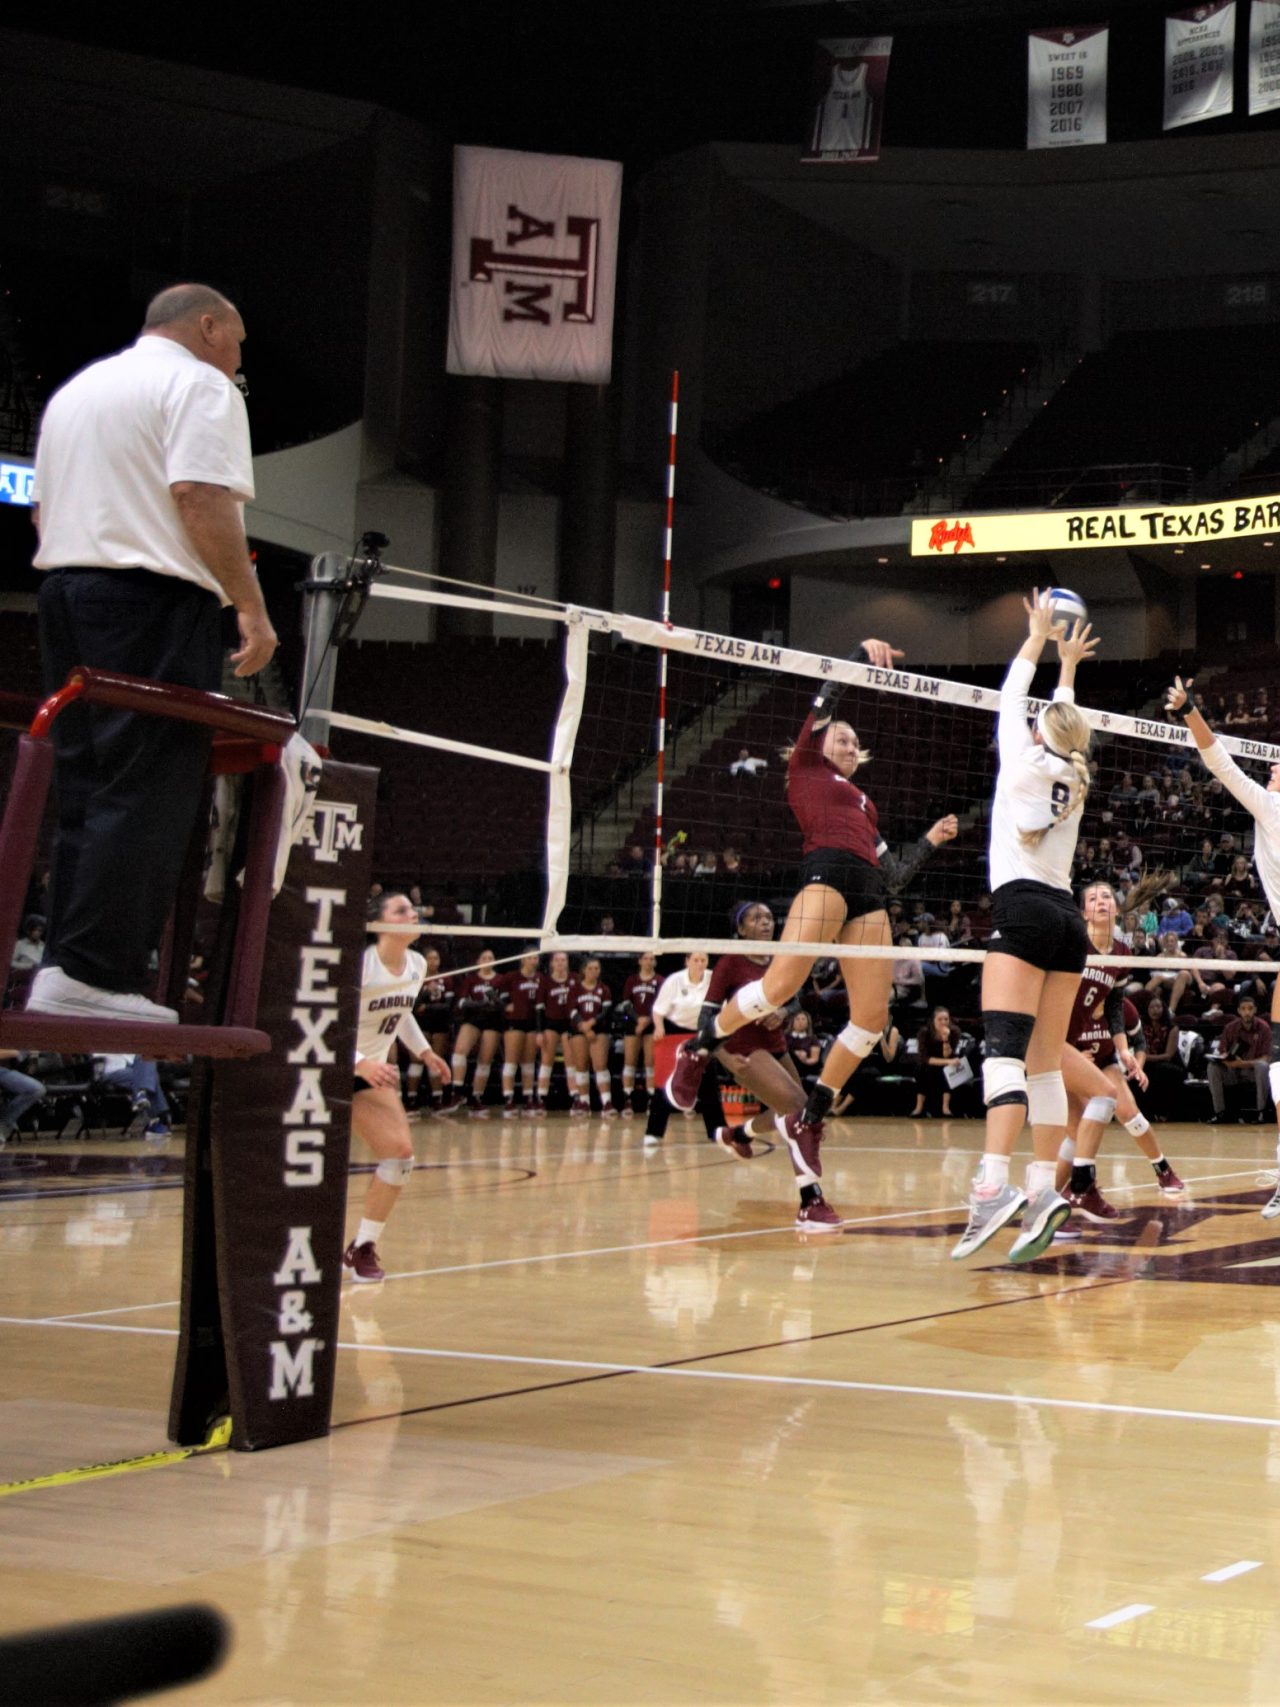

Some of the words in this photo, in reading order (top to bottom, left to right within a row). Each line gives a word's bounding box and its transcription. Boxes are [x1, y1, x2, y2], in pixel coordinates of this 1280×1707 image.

[1051, 65, 1084, 81] 1969
[1049, 100, 1084, 116] 2007
[1050, 117, 1082, 133] 2016
[970, 284, 1013, 303] 217
[1067, 515, 1136, 541] REAL
[1141, 509, 1224, 539] TEXAS
[694, 633, 746, 658] TEXAS
[751, 645, 781, 665] A&M
[867, 668, 909, 690] TEXAS
[914, 680, 941, 696] A&M
[1135, 721, 1166, 738] TEXAS
[1168, 727, 1188, 743] A&M
[1240, 741, 1267, 756] TEXAS
[1051, 781, 1070, 817] 9
[1084, 987, 1098, 1007] 6
[377, 1013, 402, 1036] 18
[284, 888, 347, 1186] TEXAS
